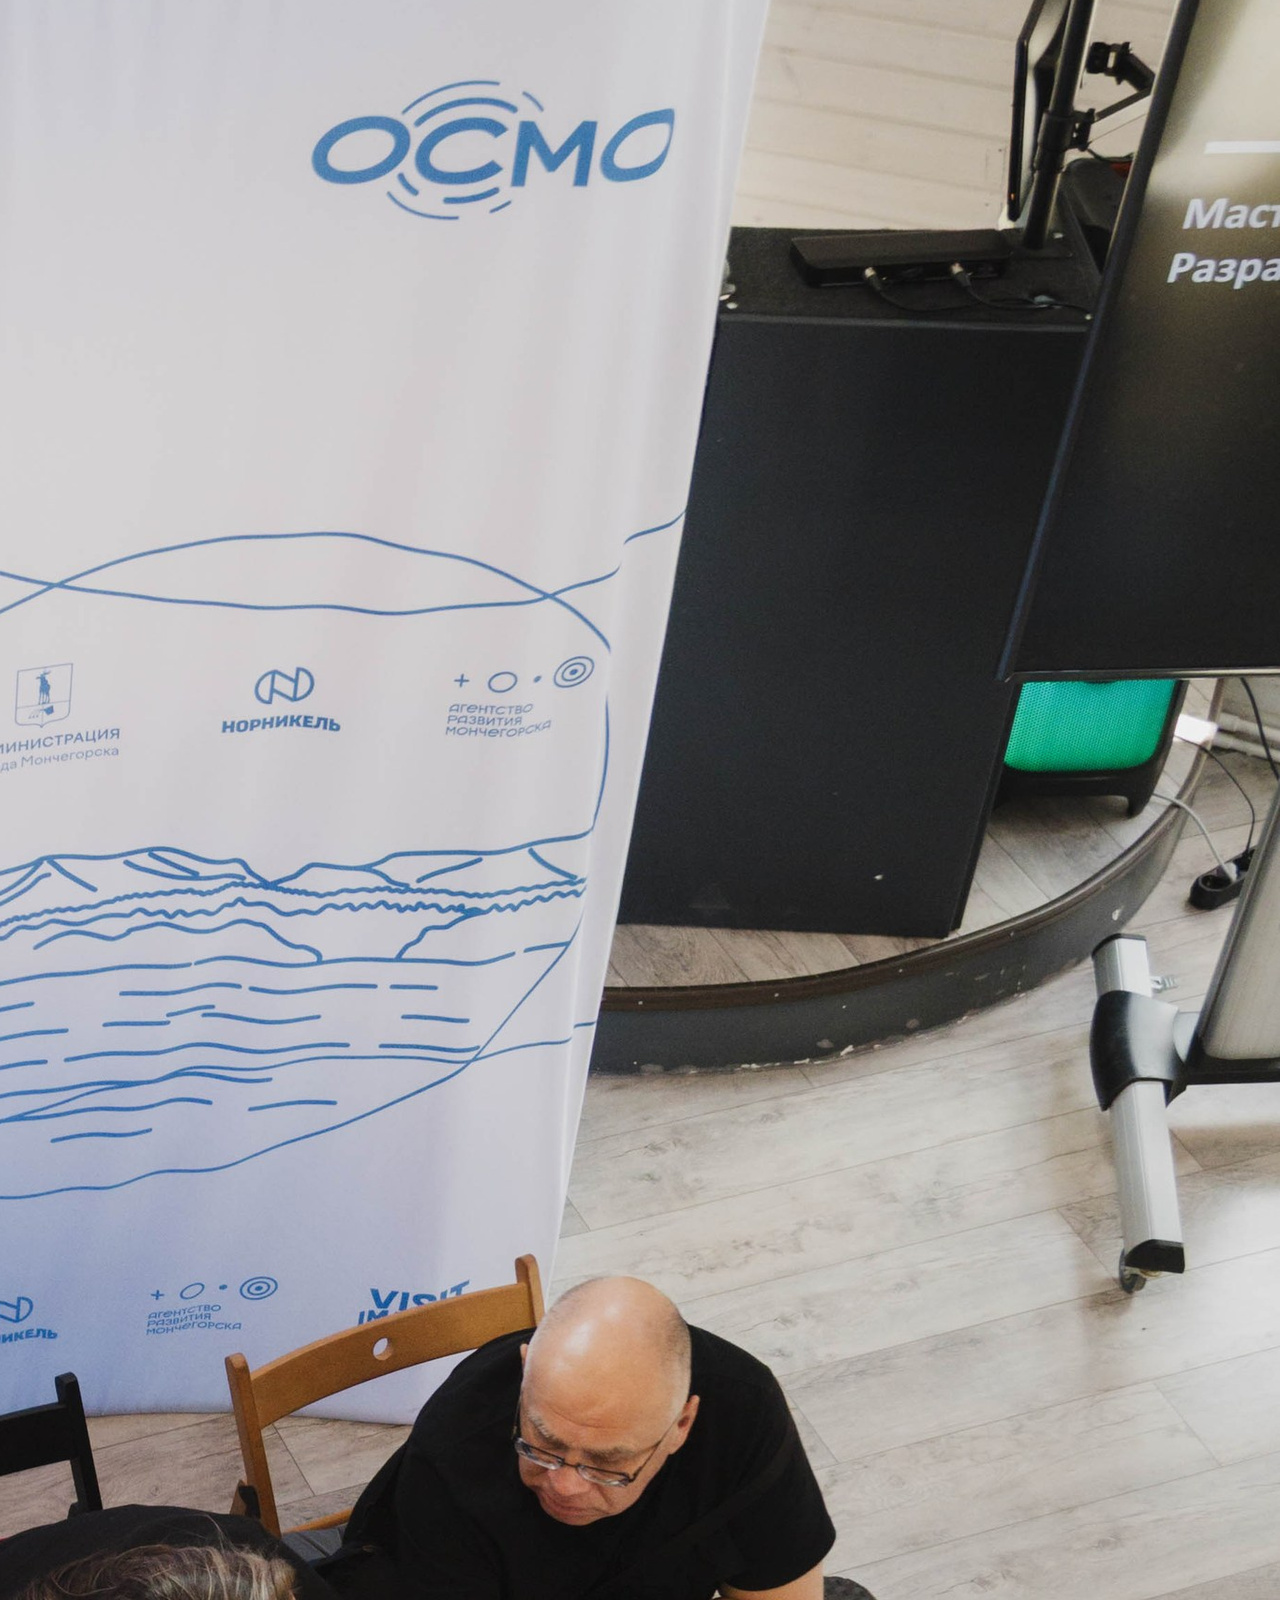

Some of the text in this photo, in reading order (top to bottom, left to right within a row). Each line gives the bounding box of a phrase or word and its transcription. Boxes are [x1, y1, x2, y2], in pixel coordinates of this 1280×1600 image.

[312, 108, 675, 187] ОСМО
[1167, 252, 1280, 290] Разра
[222, 715, 341, 733] НОРНИКЕЛЬ
[21, 747, 119, 768] Мончегорска
